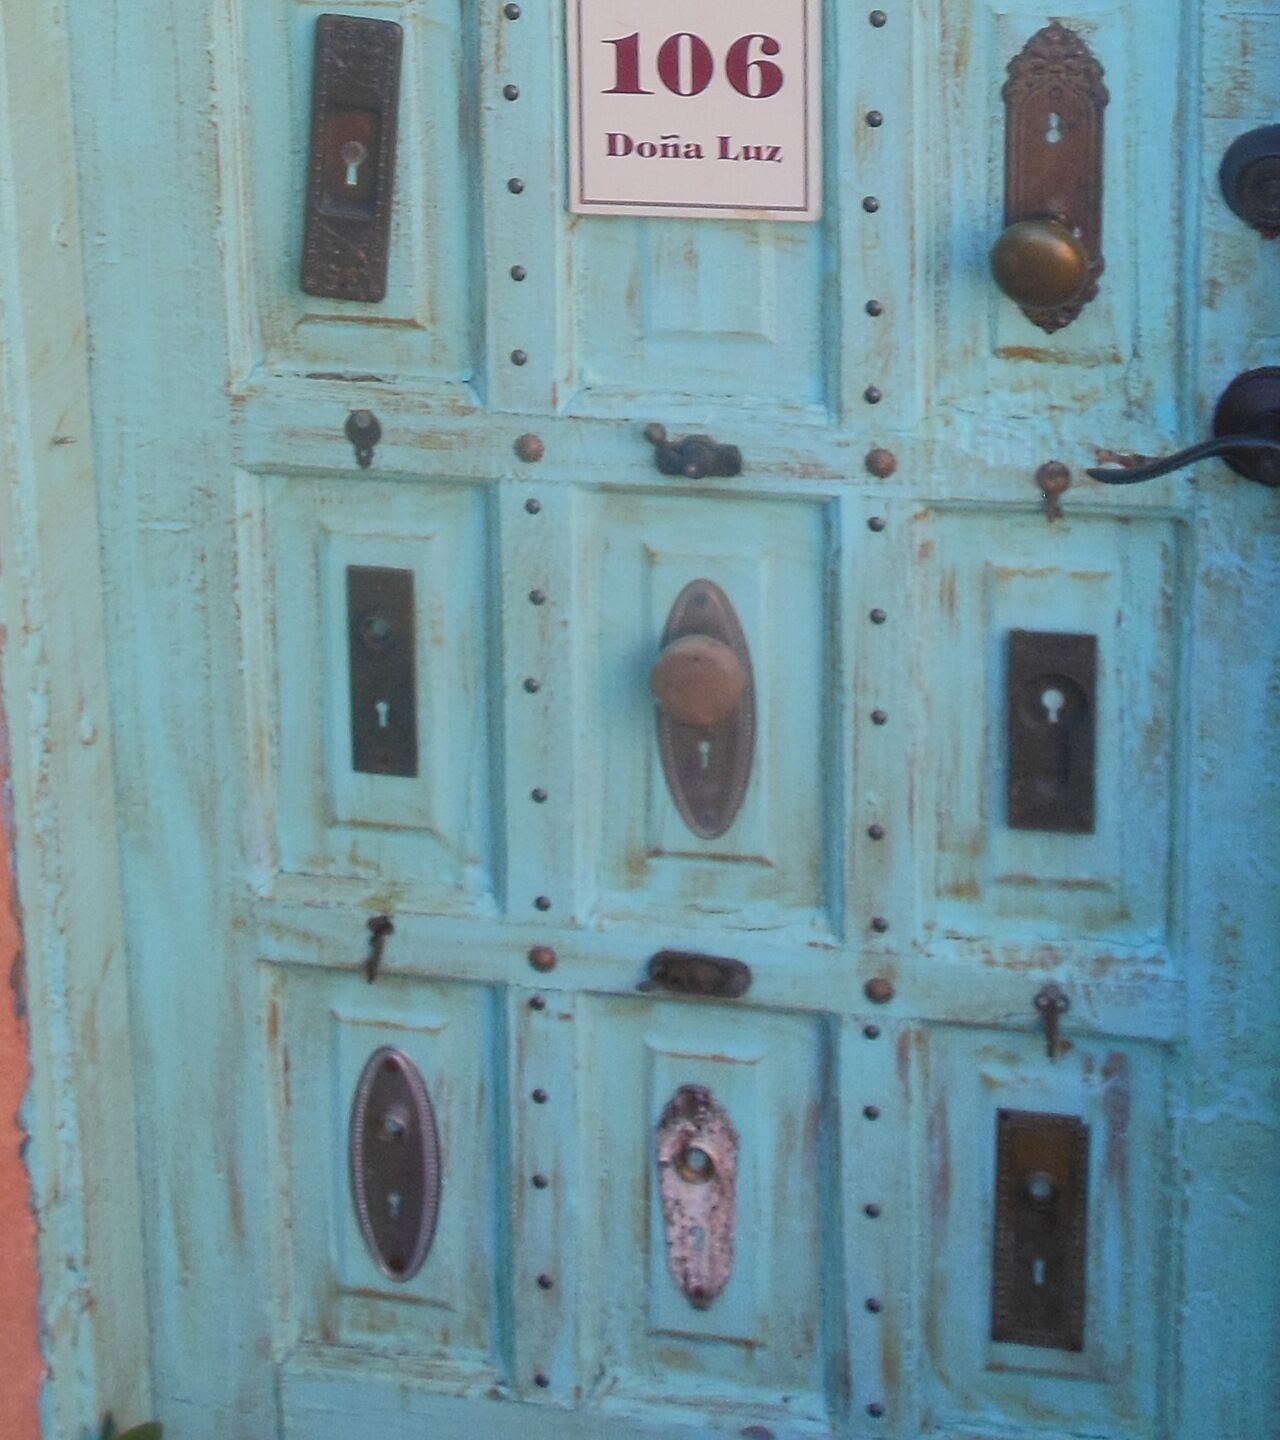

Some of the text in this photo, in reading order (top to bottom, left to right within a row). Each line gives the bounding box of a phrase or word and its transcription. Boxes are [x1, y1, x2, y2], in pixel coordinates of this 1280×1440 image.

[600, 32, 784, 98] 106
[605, 132, 782, 163] Doña Luz
